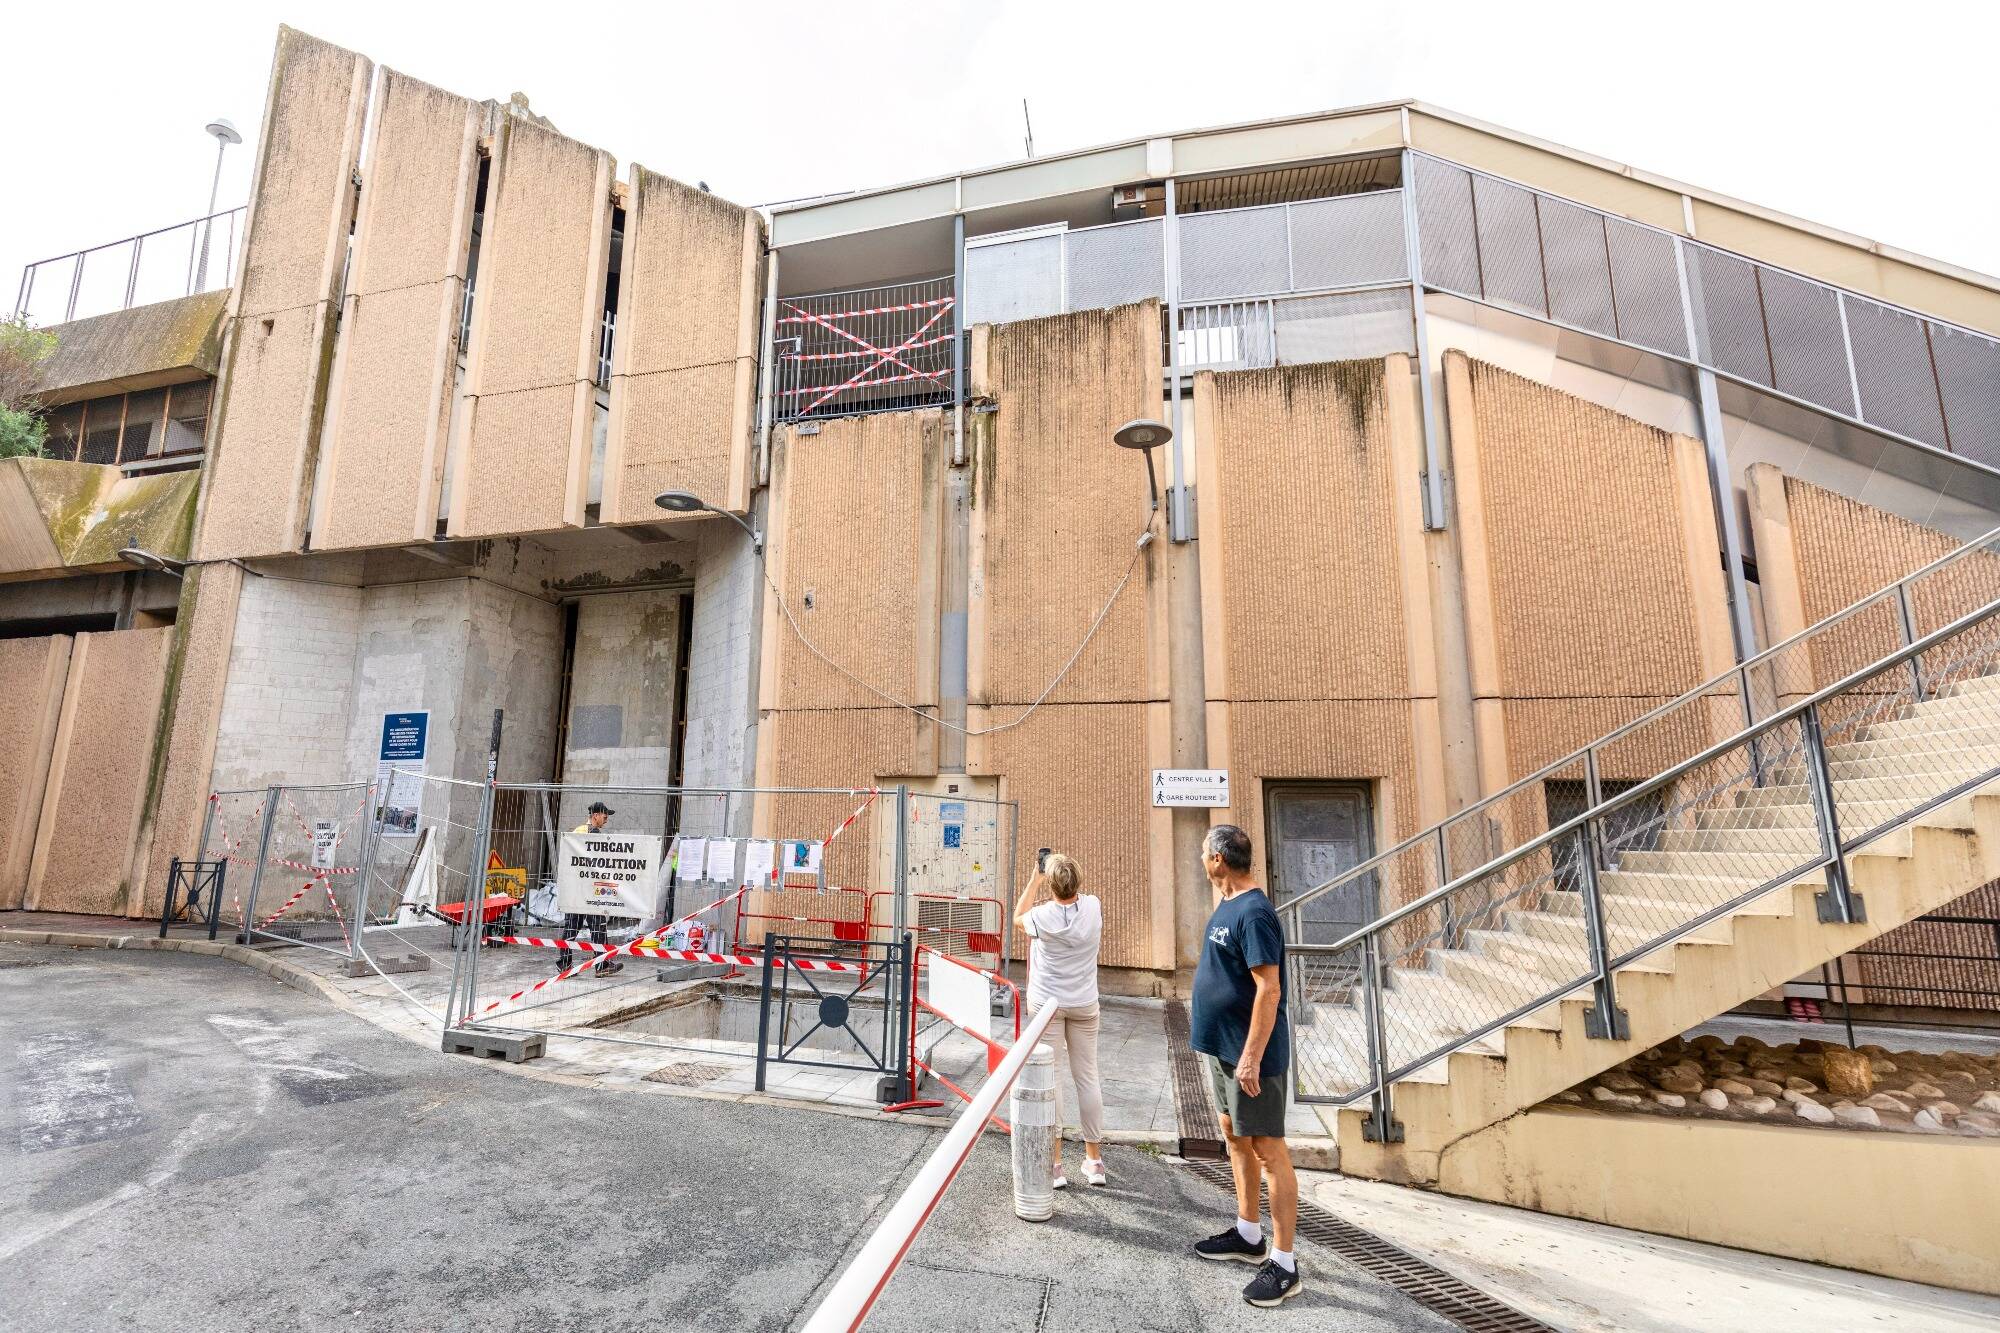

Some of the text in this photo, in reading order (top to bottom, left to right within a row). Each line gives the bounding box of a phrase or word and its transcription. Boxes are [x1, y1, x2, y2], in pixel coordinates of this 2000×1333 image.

[585, 842, 634, 853] TURCAN
[571, 856, 646, 870] DEMOLITION
[613, 873, 624, 881] 02
[625, 873, 636, 881] 00
